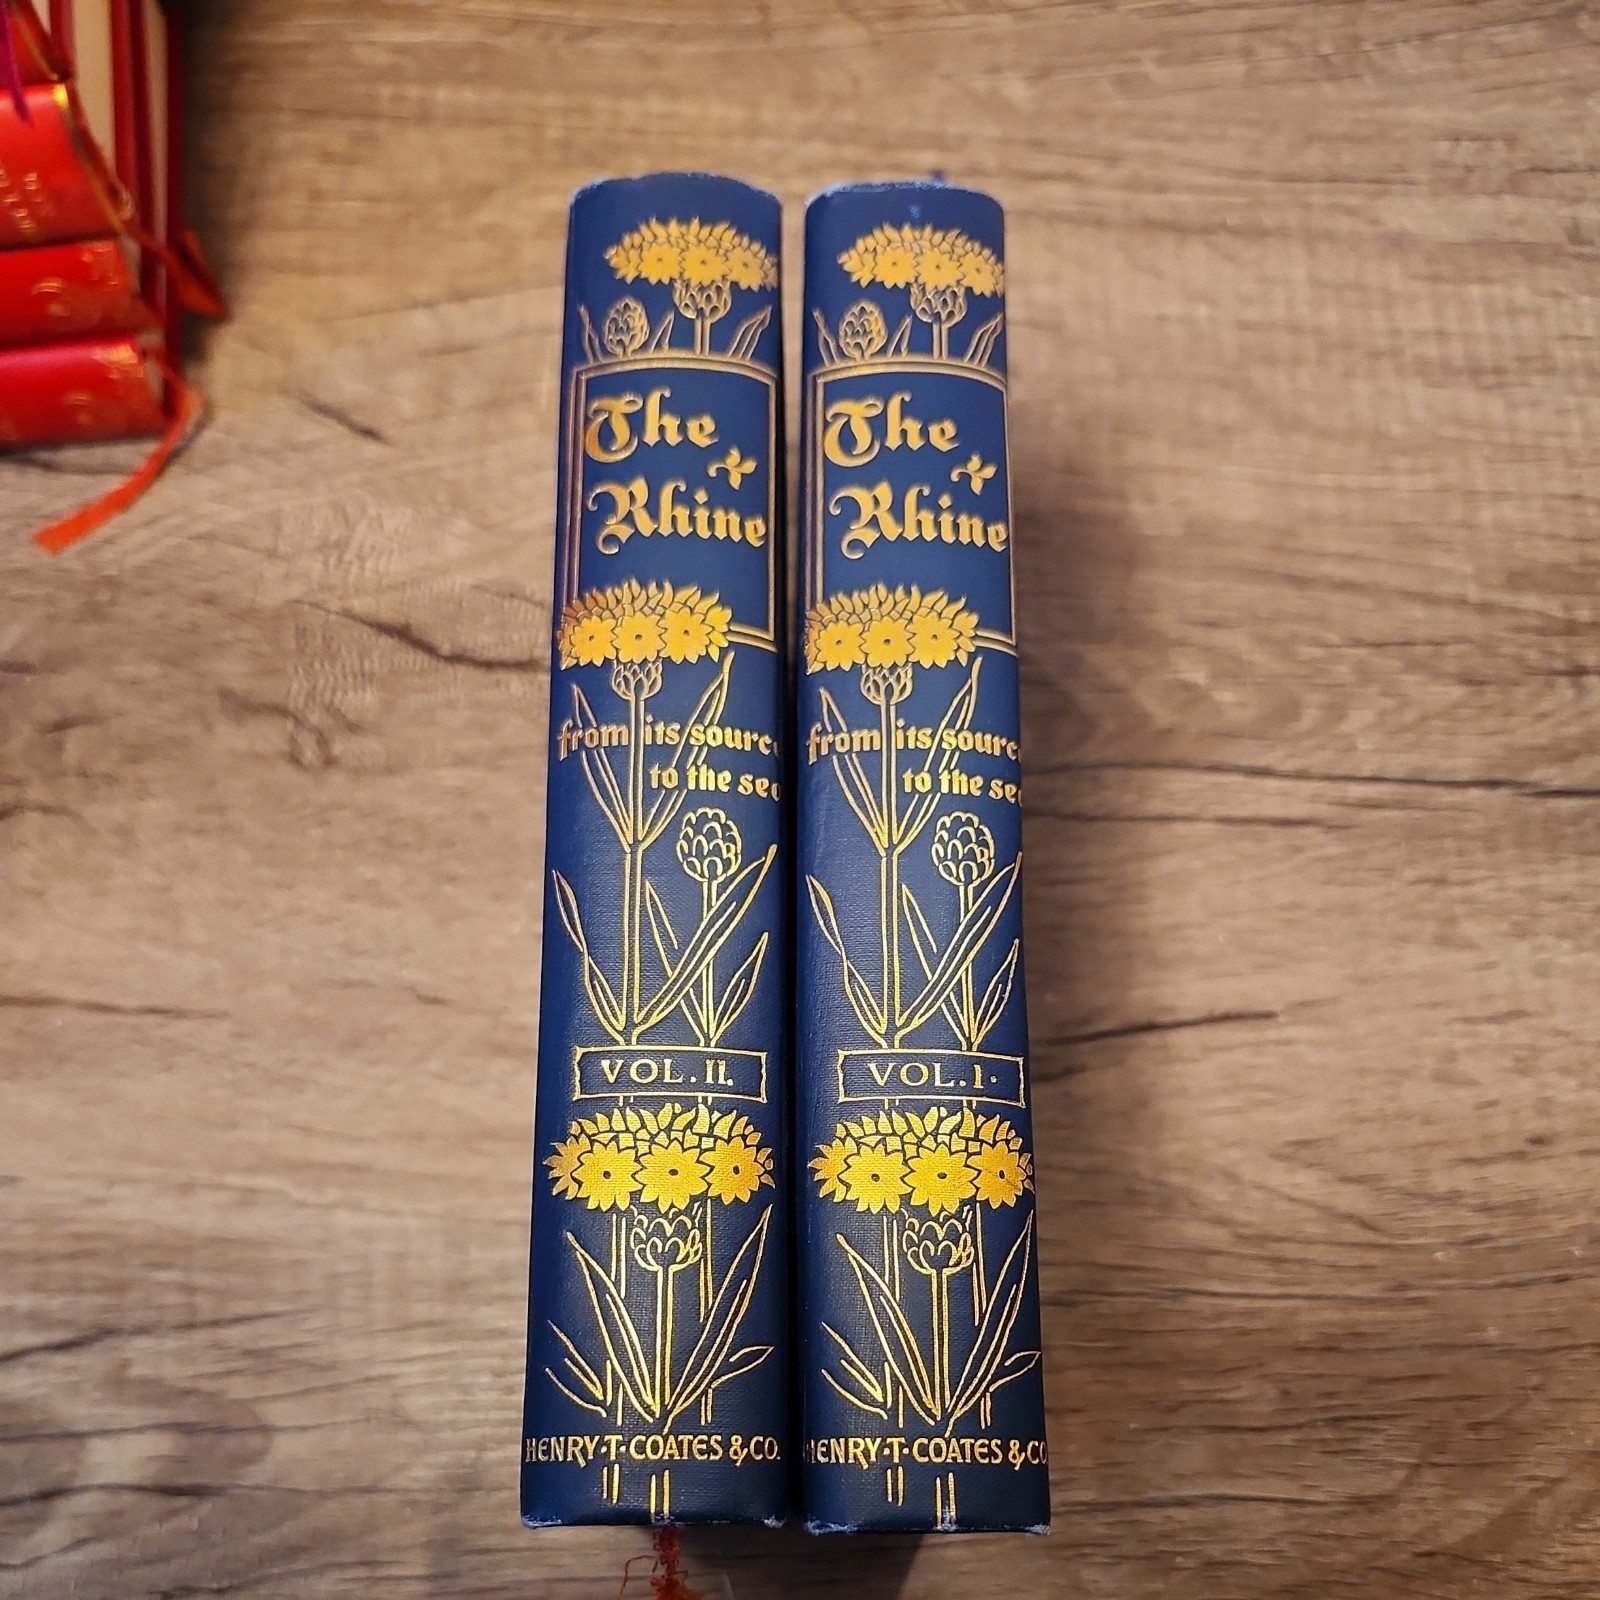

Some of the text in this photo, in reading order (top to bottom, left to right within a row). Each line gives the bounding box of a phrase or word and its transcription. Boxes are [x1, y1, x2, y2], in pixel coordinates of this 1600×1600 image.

[585, 386, 719, 463] The
[823, 390, 959, 467] The
[587, 475, 767, 555] Rhine
[829, 479, 1008, 559] Rhine
[557, 719, 629, 761] from
[645, 713, 681, 745] its
[806, 718, 1020, 765] from its sourc
[650, 762, 679, 789] to
[686, 763, 732, 793] the
[903, 768, 1022, 807] to the se
